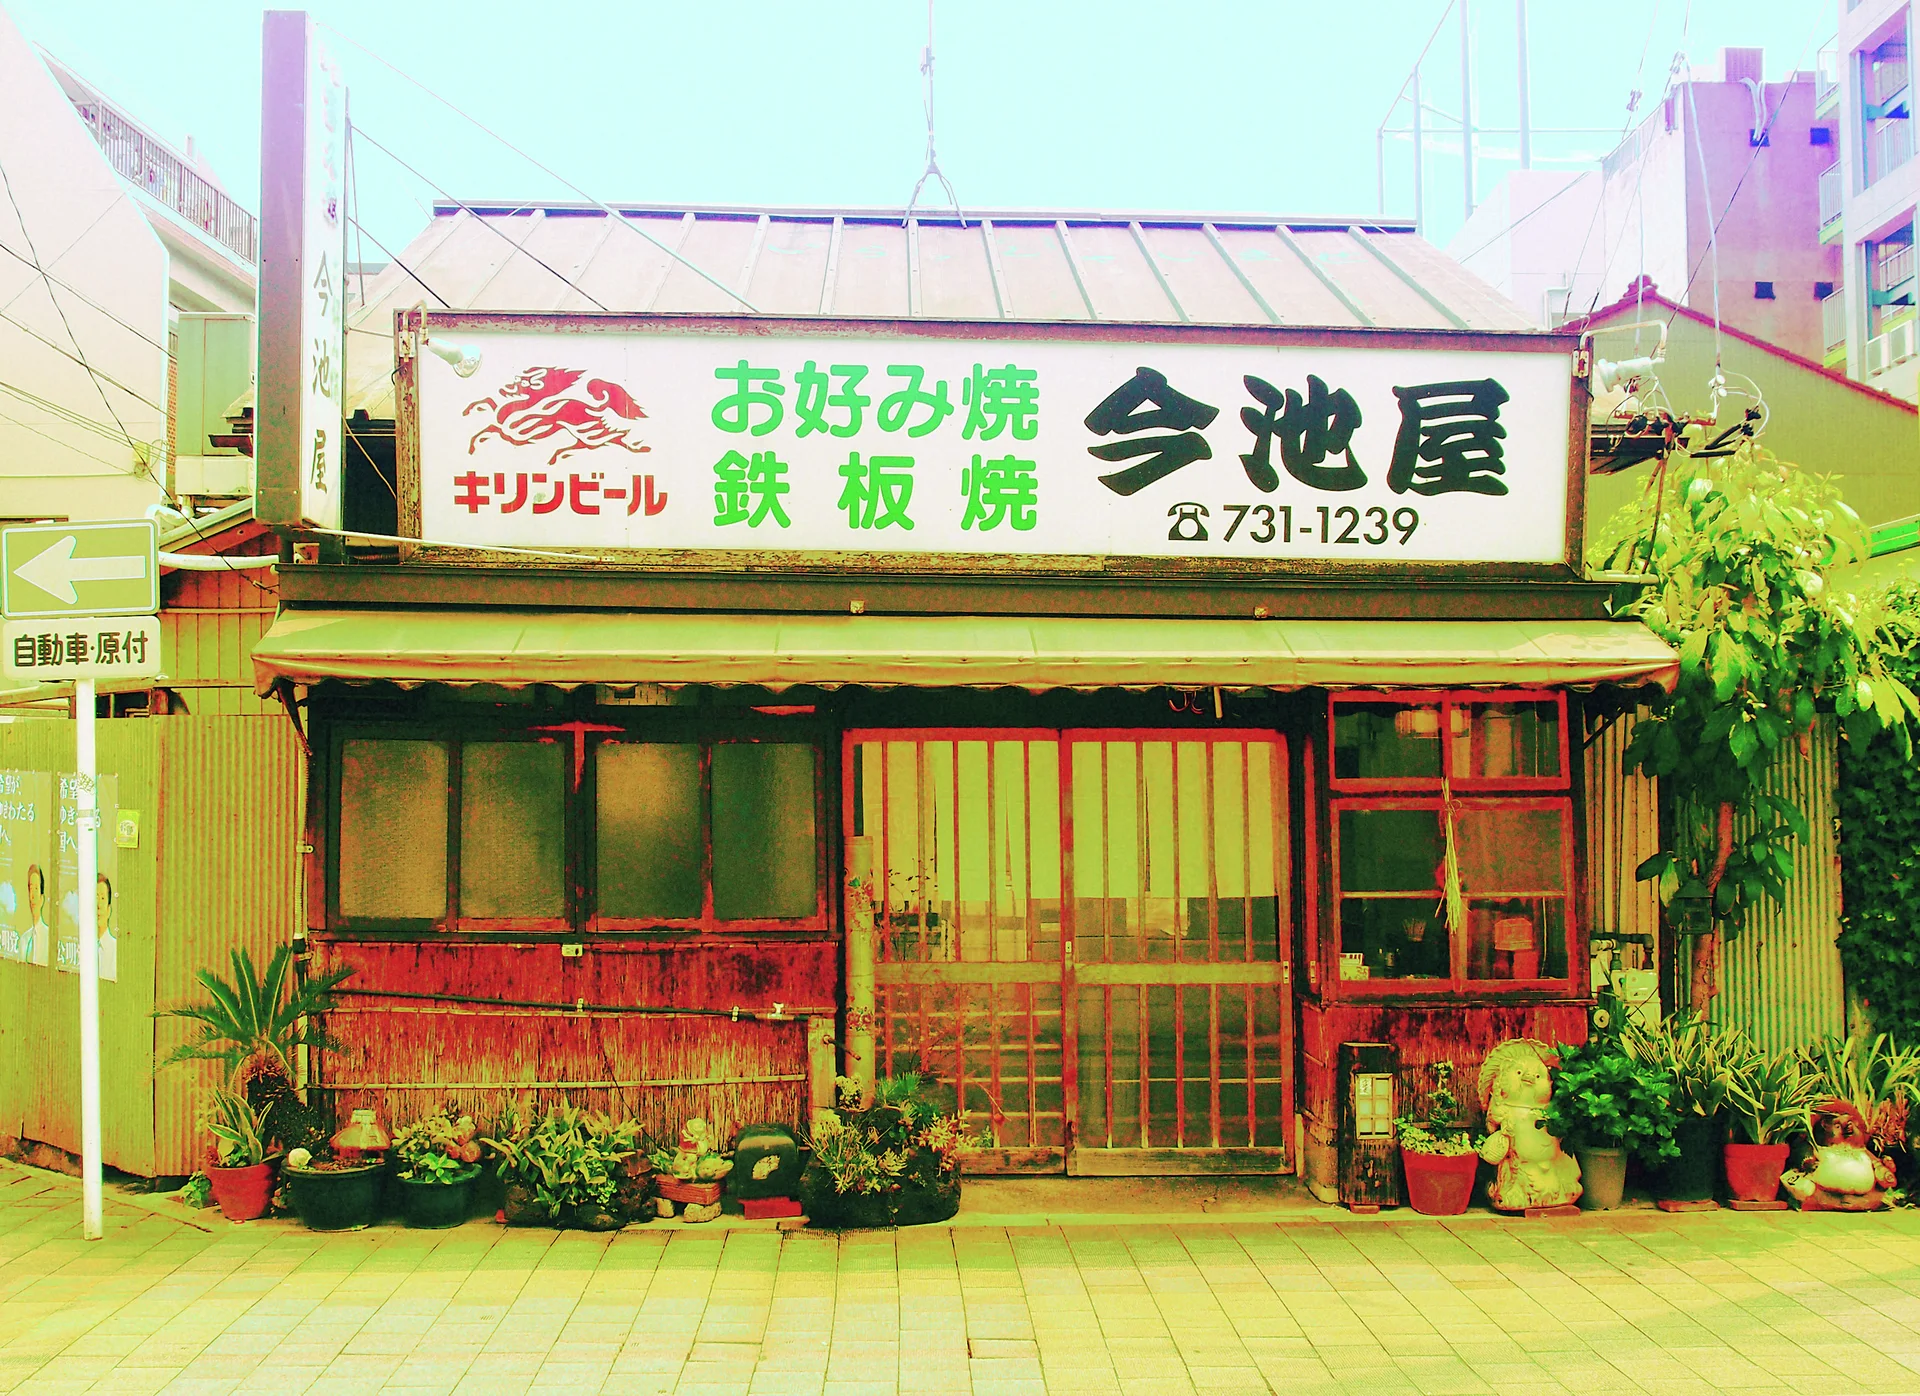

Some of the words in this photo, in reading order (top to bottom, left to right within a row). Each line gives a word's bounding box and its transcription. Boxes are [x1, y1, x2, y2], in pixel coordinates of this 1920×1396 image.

[311, 250, 332, 495] 今池屋
[711, 359, 1039, 442] お好み焼
[1084, 366, 1510, 496] 今池屋
[453, 470, 668, 517] キリンビール
[712, 449, 1039, 532] 鉄板焼
[1223, 504, 1419, 546] 731-1239
[0, 929, 19, 954] 明党
[57, 940, 80, 966] 公明
